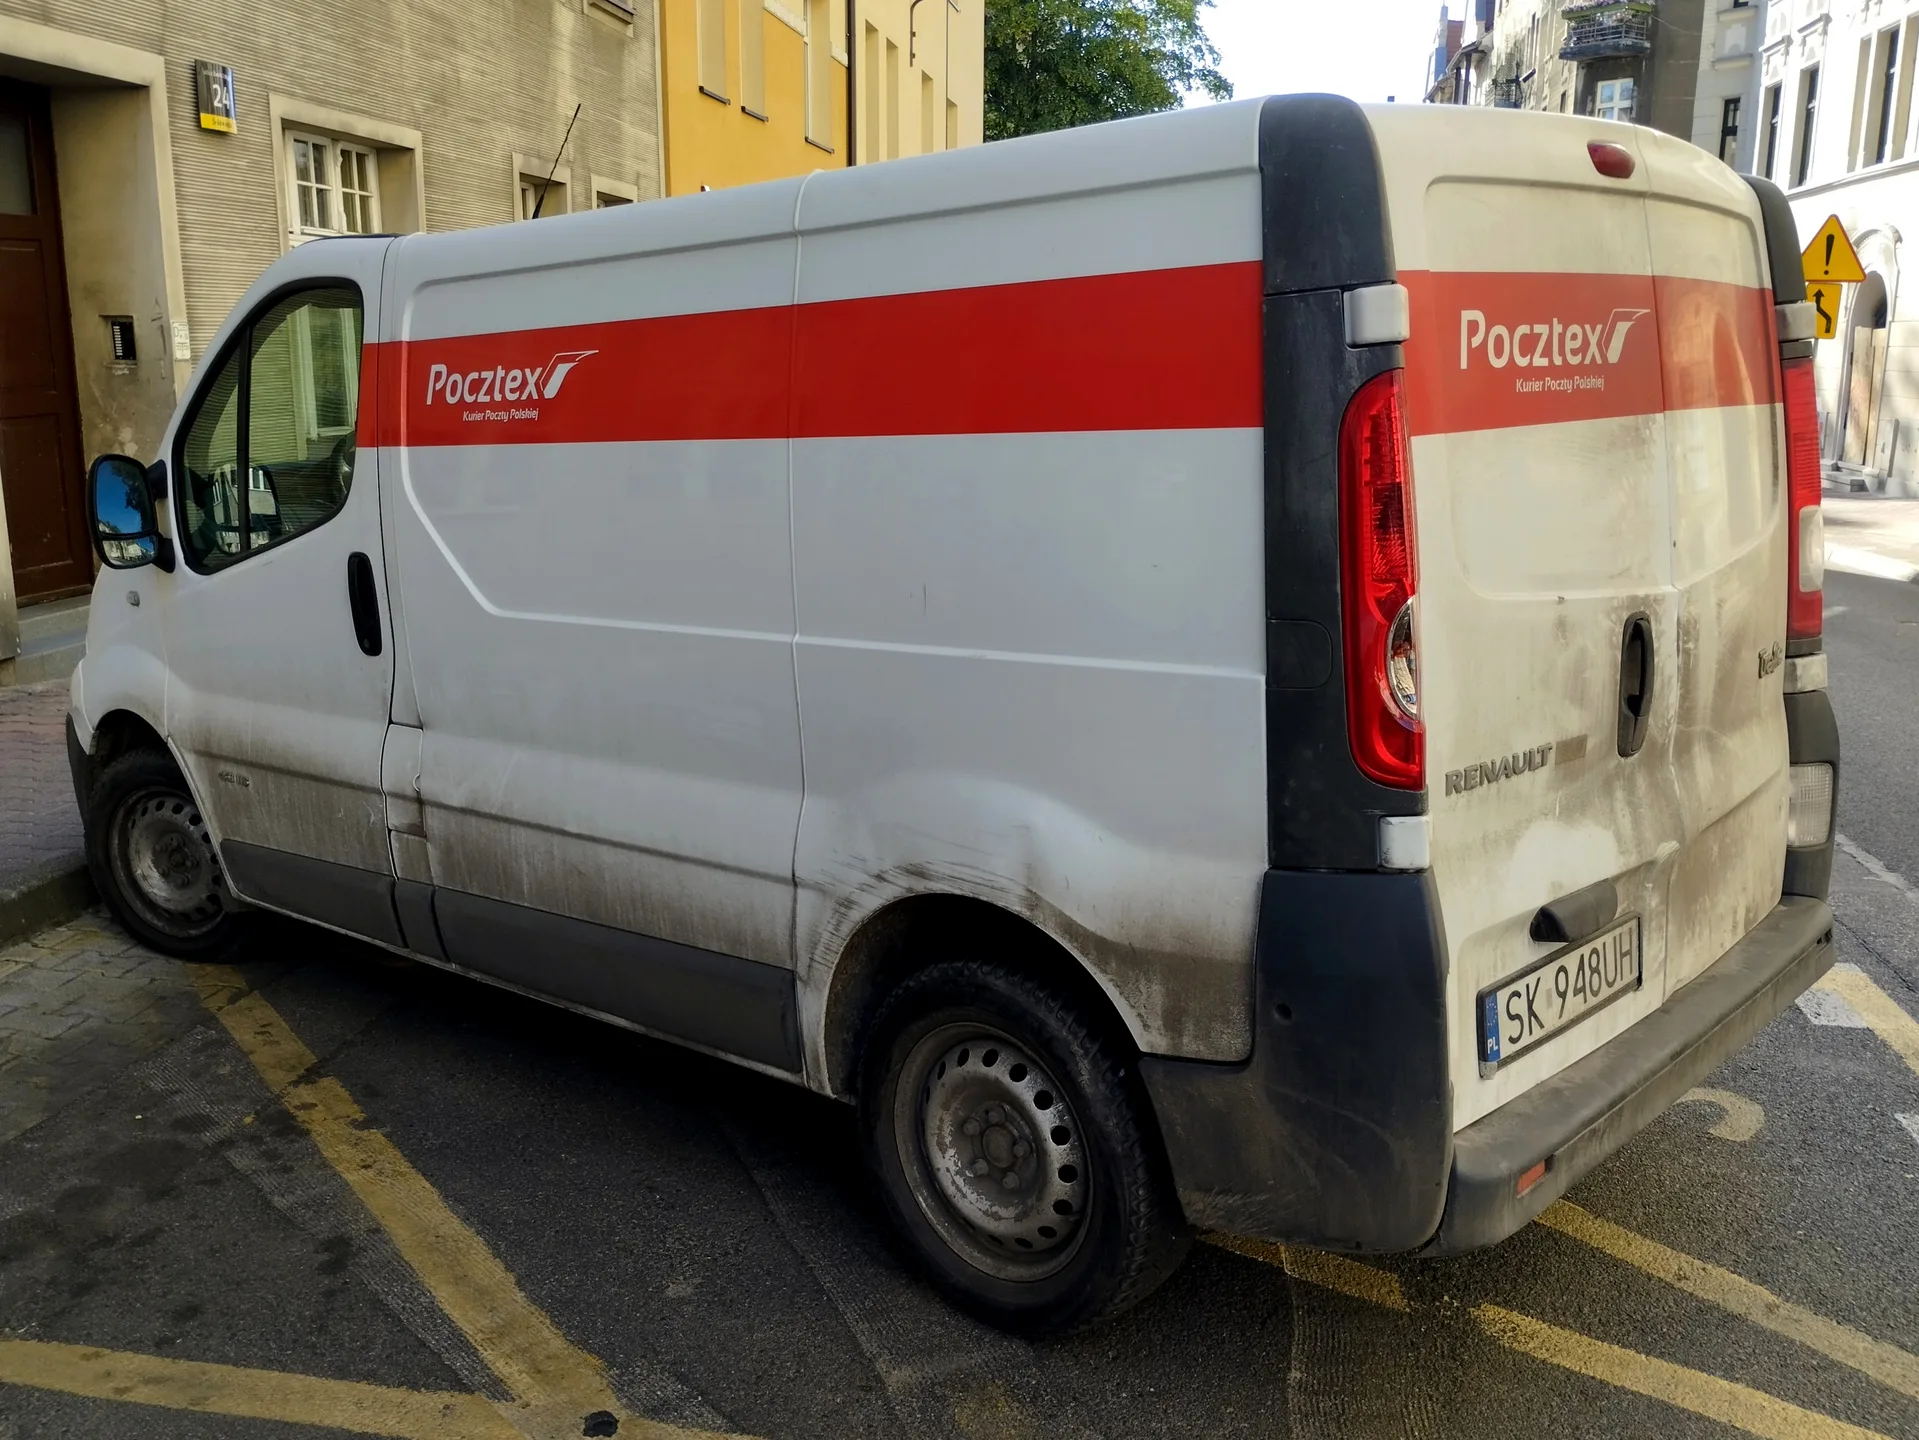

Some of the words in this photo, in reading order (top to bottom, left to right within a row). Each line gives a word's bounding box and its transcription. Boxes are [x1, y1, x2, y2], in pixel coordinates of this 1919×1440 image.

[212, 84, 230, 109] 24
[1460, 309, 1603, 370] Pocztex
[426, 363, 544, 405] Pocztex
[1516, 377, 1543, 393] Kurier
[1544, 377, 1573, 393] Poczty
[1574, 375, 1605, 392] Polskiej
[463, 410, 485, 422] Kurier
[485, 409, 509, 423] Poczty
[509, 407, 539, 421] Polskiej
[1445, 742, 1553, 797] RENAULT
[1506, 976, 1545, 1045] SK
[1554, 926, 1633, 1020] 948UH
[1487, 1036, 1499, 1054] PL
